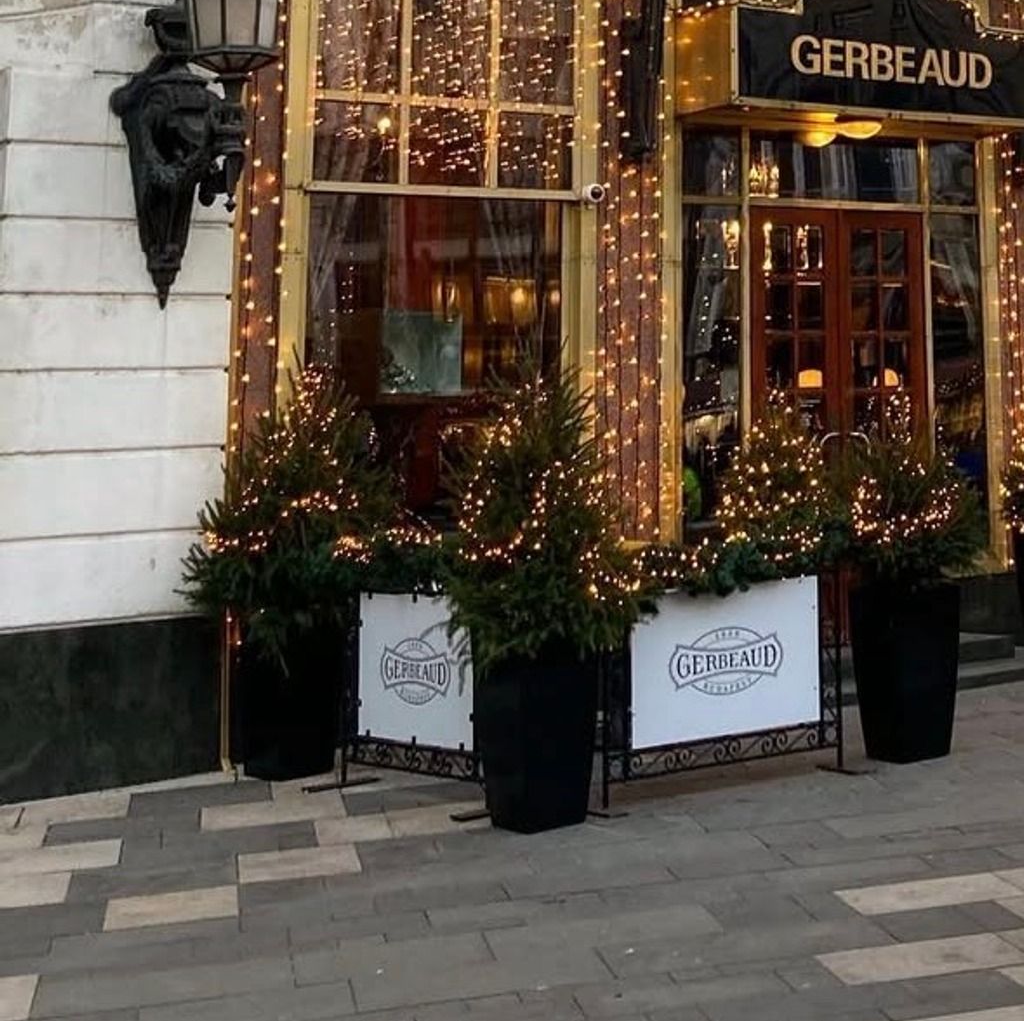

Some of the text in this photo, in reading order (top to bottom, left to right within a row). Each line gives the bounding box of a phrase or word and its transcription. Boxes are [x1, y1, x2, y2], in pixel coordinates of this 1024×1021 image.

[790, 34, 993, 90] GERBEAUD
[384, 655, 447, 686] GERBEAUD
[676, 643, 778, 679] GERBEAUD
